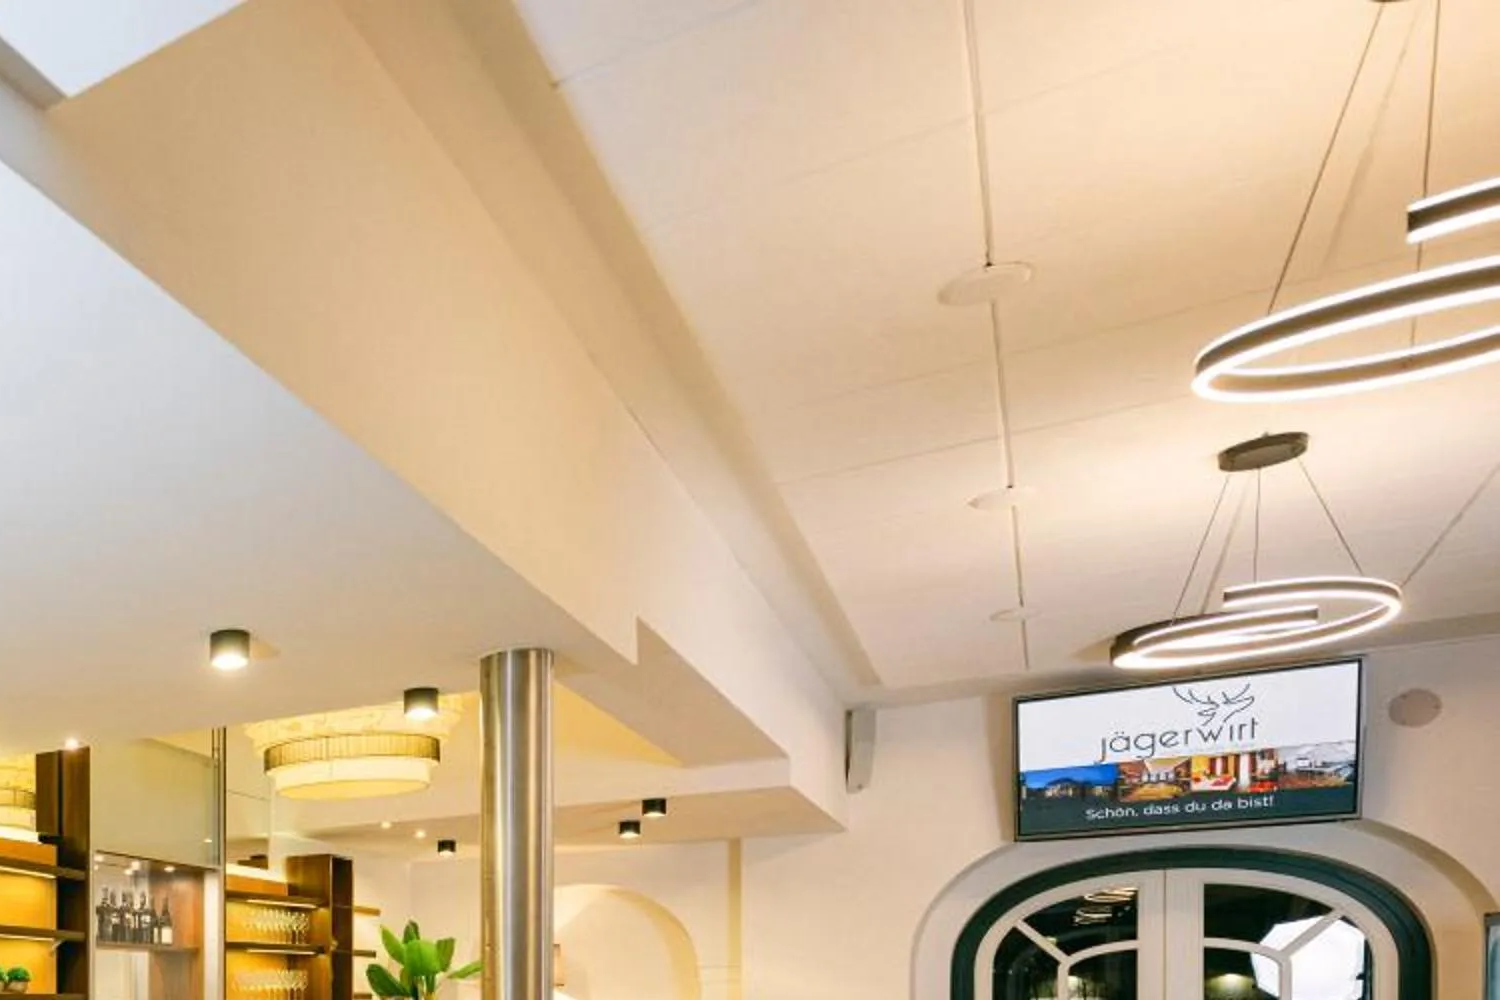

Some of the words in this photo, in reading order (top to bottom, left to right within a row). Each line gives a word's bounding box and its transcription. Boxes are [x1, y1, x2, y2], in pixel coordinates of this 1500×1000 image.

[1094, 717, 1259, 764] jägerwirt
[1143, 803, 1181, 815] dass
[1184, 799, 1207, 813] du
[1211, 798, 1233, 811] da
[1237, 795, 1275, 809] bist!
